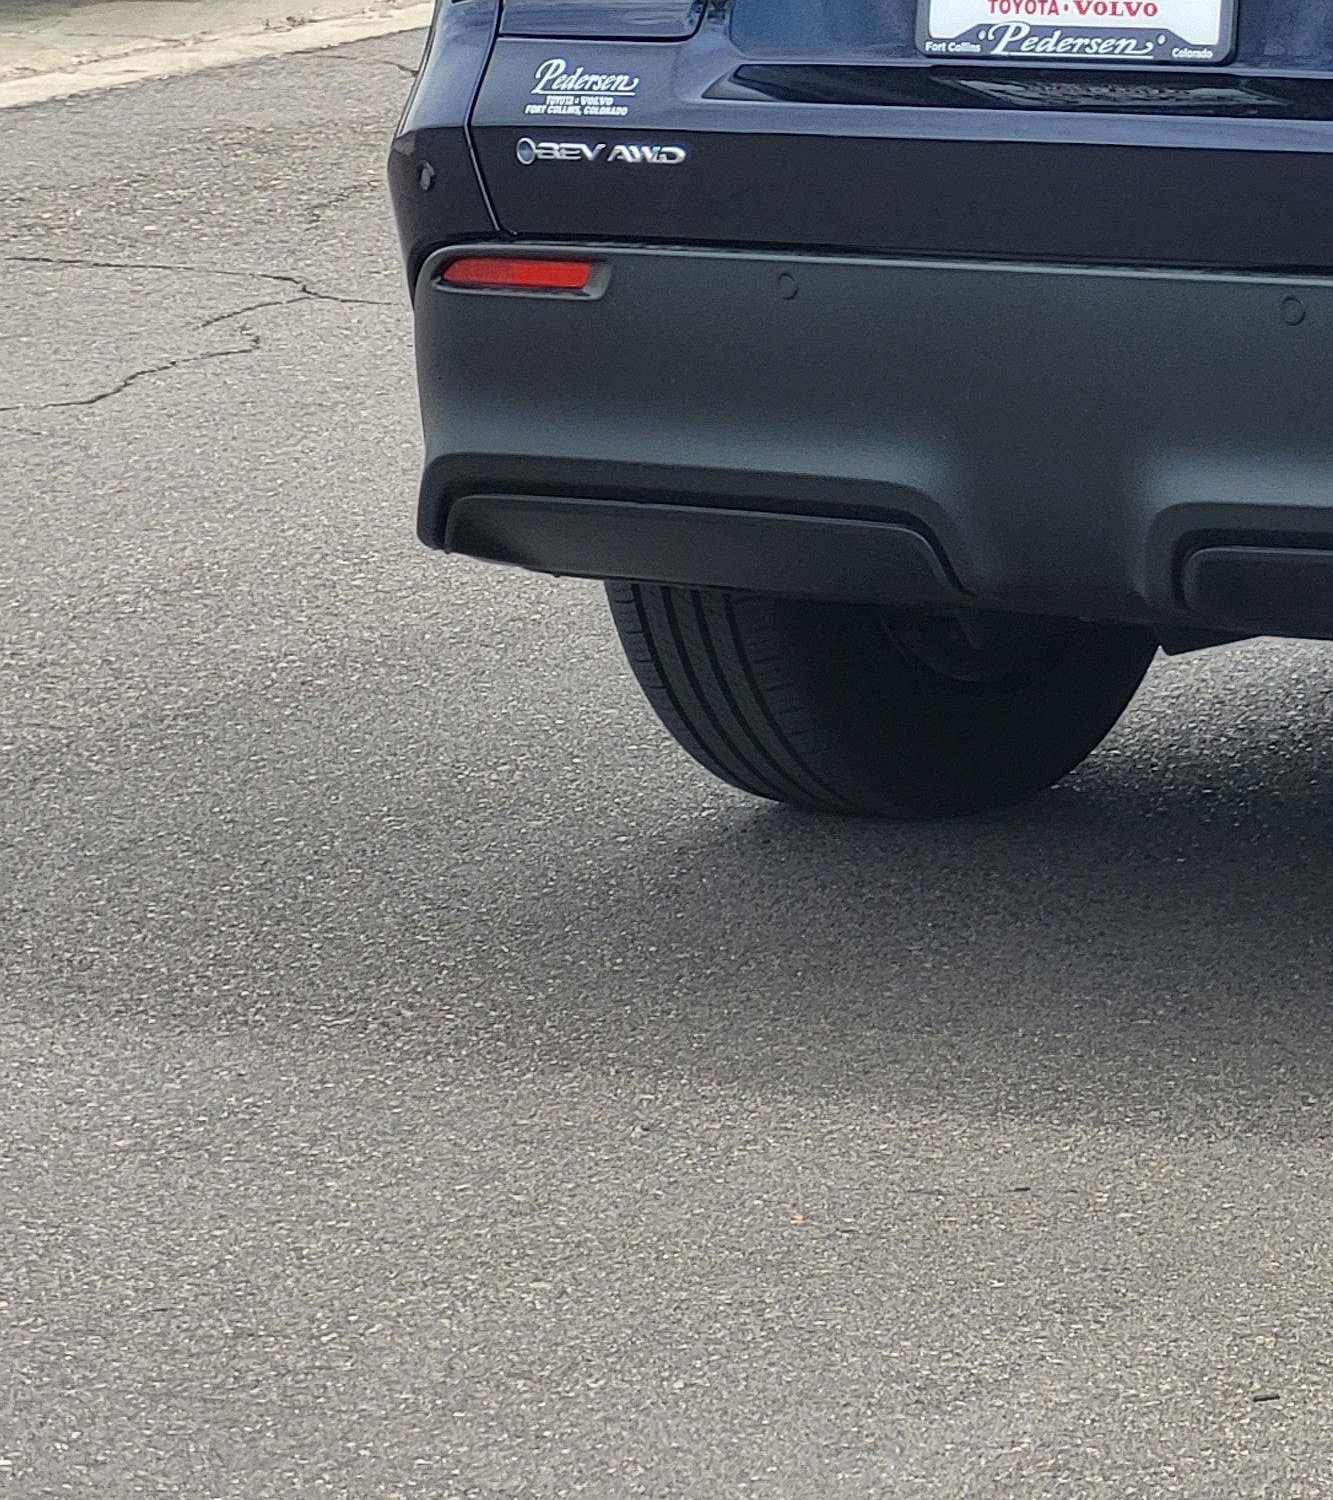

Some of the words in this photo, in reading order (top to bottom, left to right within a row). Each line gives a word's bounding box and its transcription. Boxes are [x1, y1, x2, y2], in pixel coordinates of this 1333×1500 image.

[1073, 0, 1158, 17] VOLVO
[926, 41, 947, 52] Fort
[948, 41, 981, 53] Collins
[987, 21, 1154, 56] Pedersen
[1172, 48, 1213, 59] Colorado
[531, 58, 639, 94] Pedersen
[580, 96, 614, 106] VOLVO
[535, 142, 606, 162] BEV
[607, 145, 687, 165] AWD
